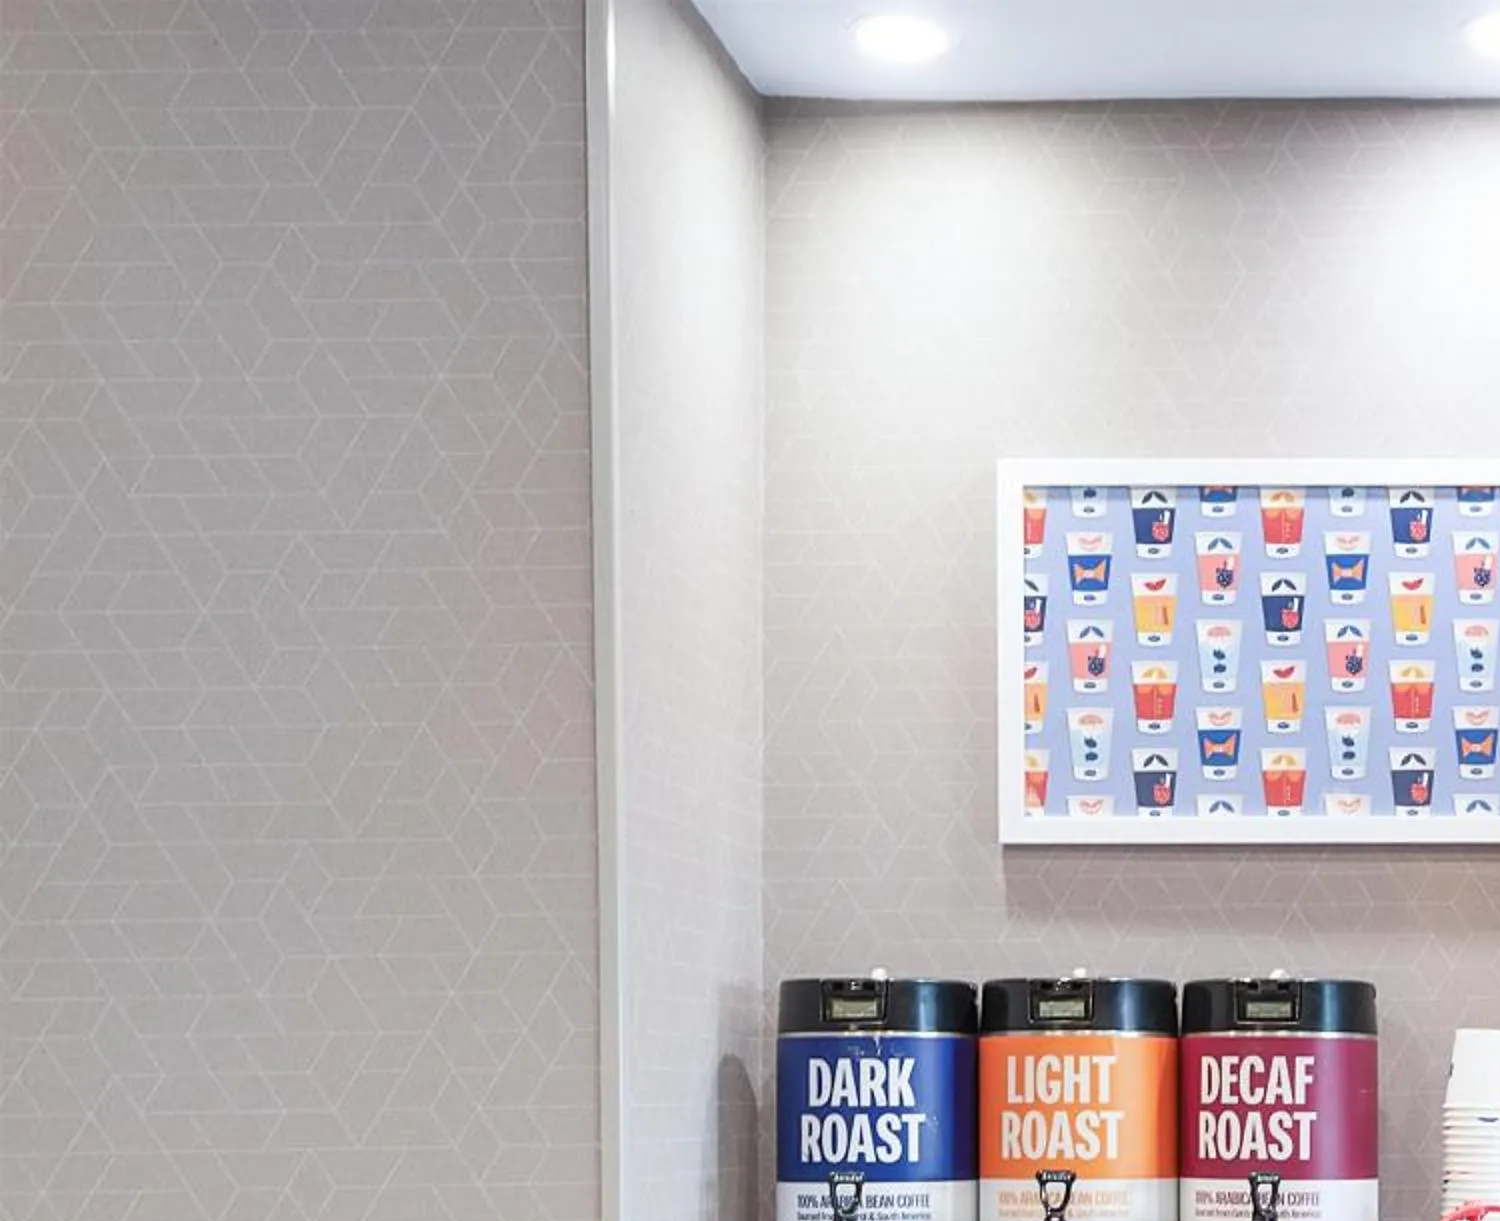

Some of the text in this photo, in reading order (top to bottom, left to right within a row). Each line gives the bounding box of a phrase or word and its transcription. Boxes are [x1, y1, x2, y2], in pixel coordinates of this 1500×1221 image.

[808, 1057, 916, 1107] DARK
[1007, 1055, 1117, 1105] LIGHT
[1200, 1055, 1315, 1105] DECAF
[801, 1113, 927, 1163] ROAST
[1001, 1110, 1125, 1161] ROAST
[1199, 1110, 1318, 1161] ROAST
[865, 1194, 895, 1208] BEAN
[897, 1194, 930, 1208] COFFEE
[1288, 1191, 1319, 1205] COFFEE
